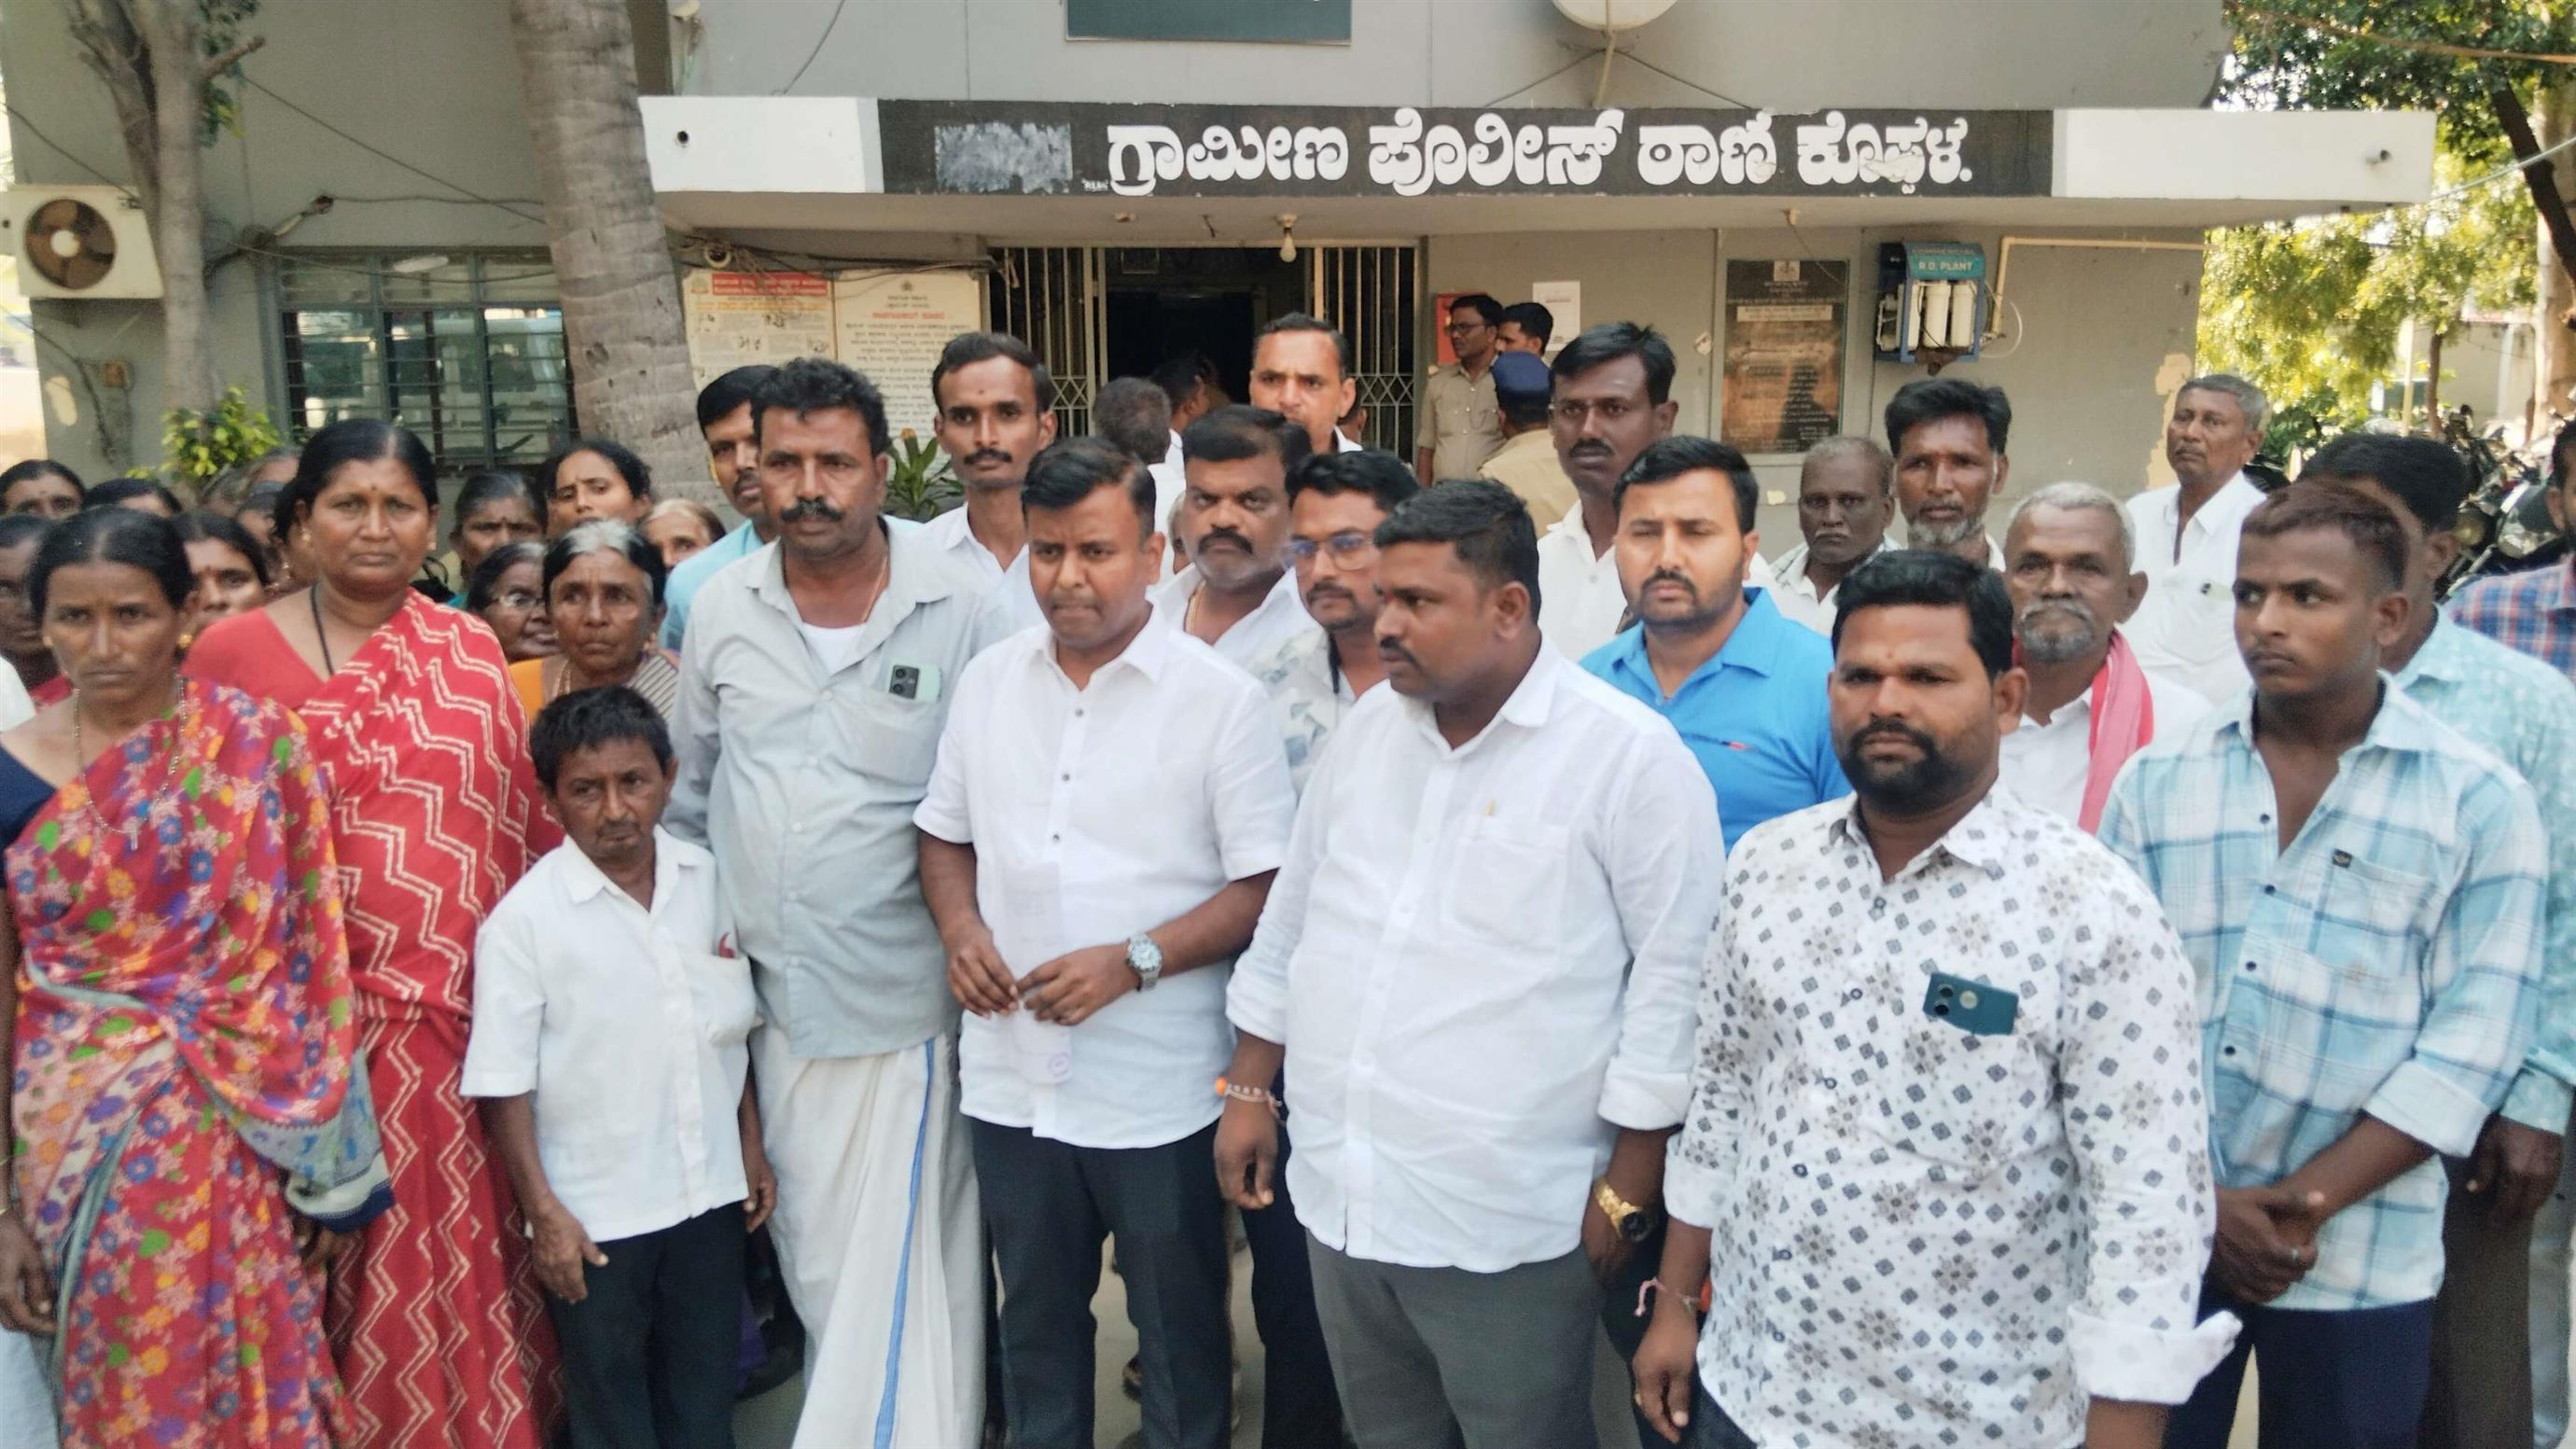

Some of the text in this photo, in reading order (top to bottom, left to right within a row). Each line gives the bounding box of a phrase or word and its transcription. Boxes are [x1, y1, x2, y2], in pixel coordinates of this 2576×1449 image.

[1107, 124, 1349, 197] ಗ್ರಾಮೀಣ
[1368, 106, 1625, 197] ಪೊಲೀಸ್
[1940, 261, 1973, 271] PLANT
